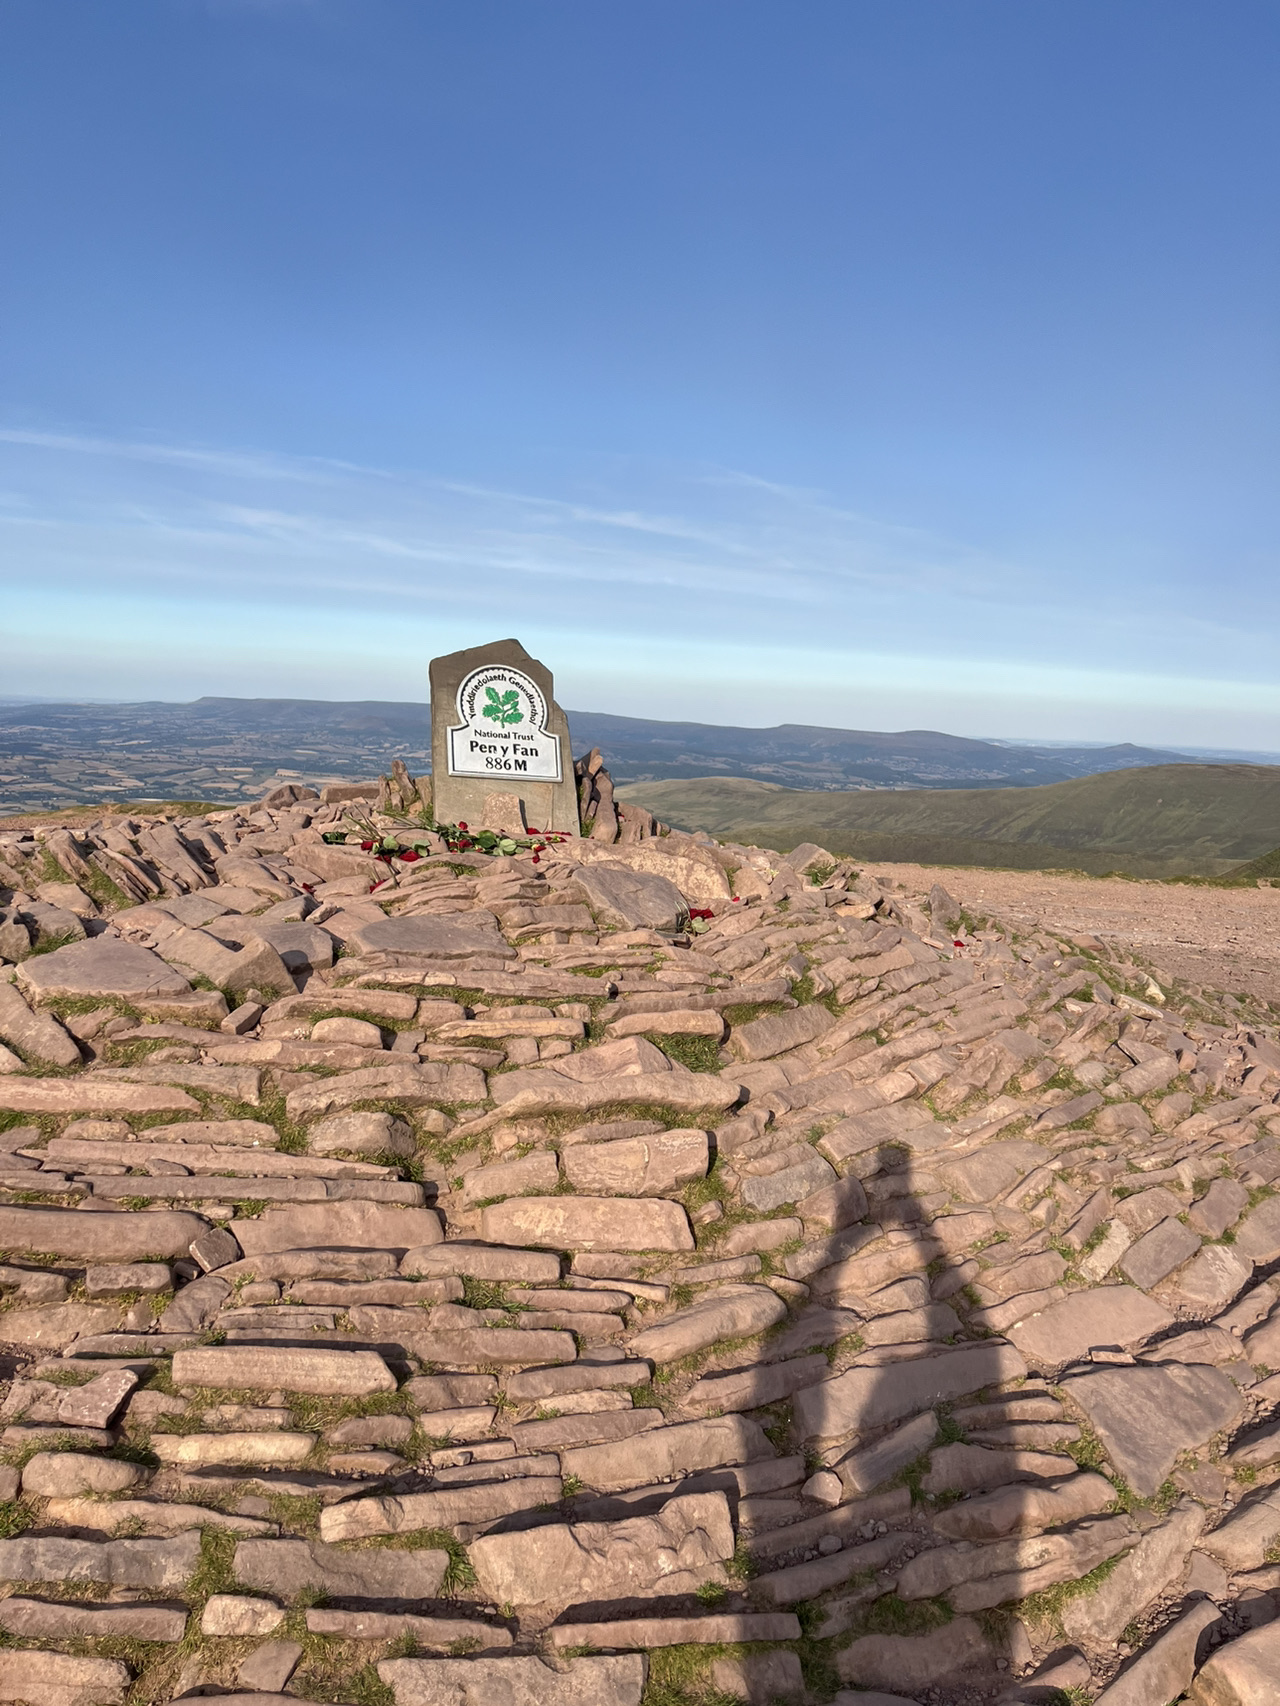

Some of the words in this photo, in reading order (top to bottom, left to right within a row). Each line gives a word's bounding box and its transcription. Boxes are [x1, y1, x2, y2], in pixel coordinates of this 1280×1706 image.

[474, 729, 510, 739] National
[512, 732, 534, 741] Trust
[469, 740, 497, 754] Pen
[500, 745, 509, 757] y
[513, 743, 539, 757] Fan
